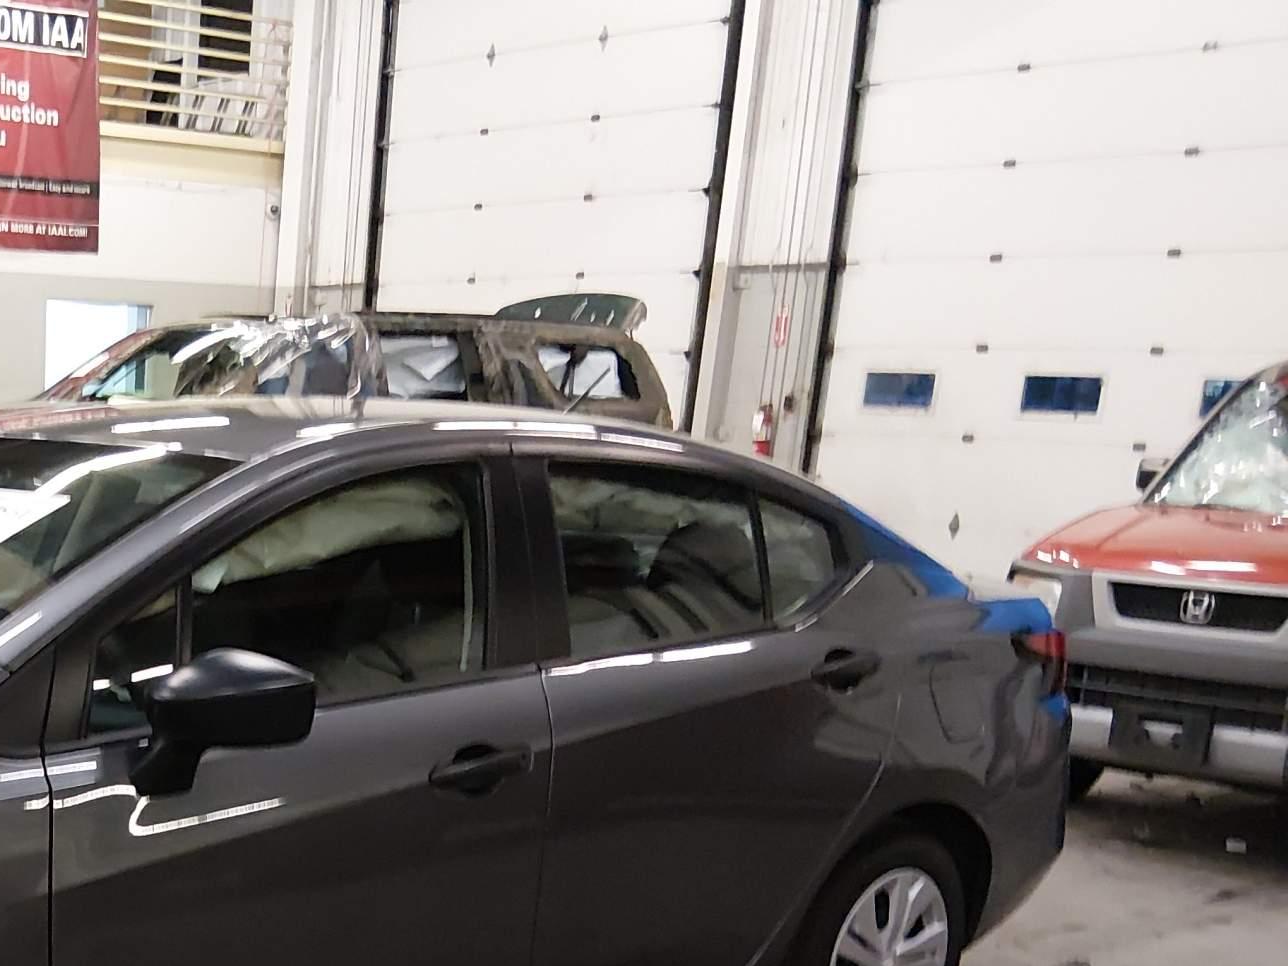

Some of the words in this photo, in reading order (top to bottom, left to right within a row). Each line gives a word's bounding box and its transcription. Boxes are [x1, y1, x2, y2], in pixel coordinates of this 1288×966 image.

[43, 14, 84, 49] IAA
[11, 221, 34, 235] MORE
[36, 224, 46, 236] AT
